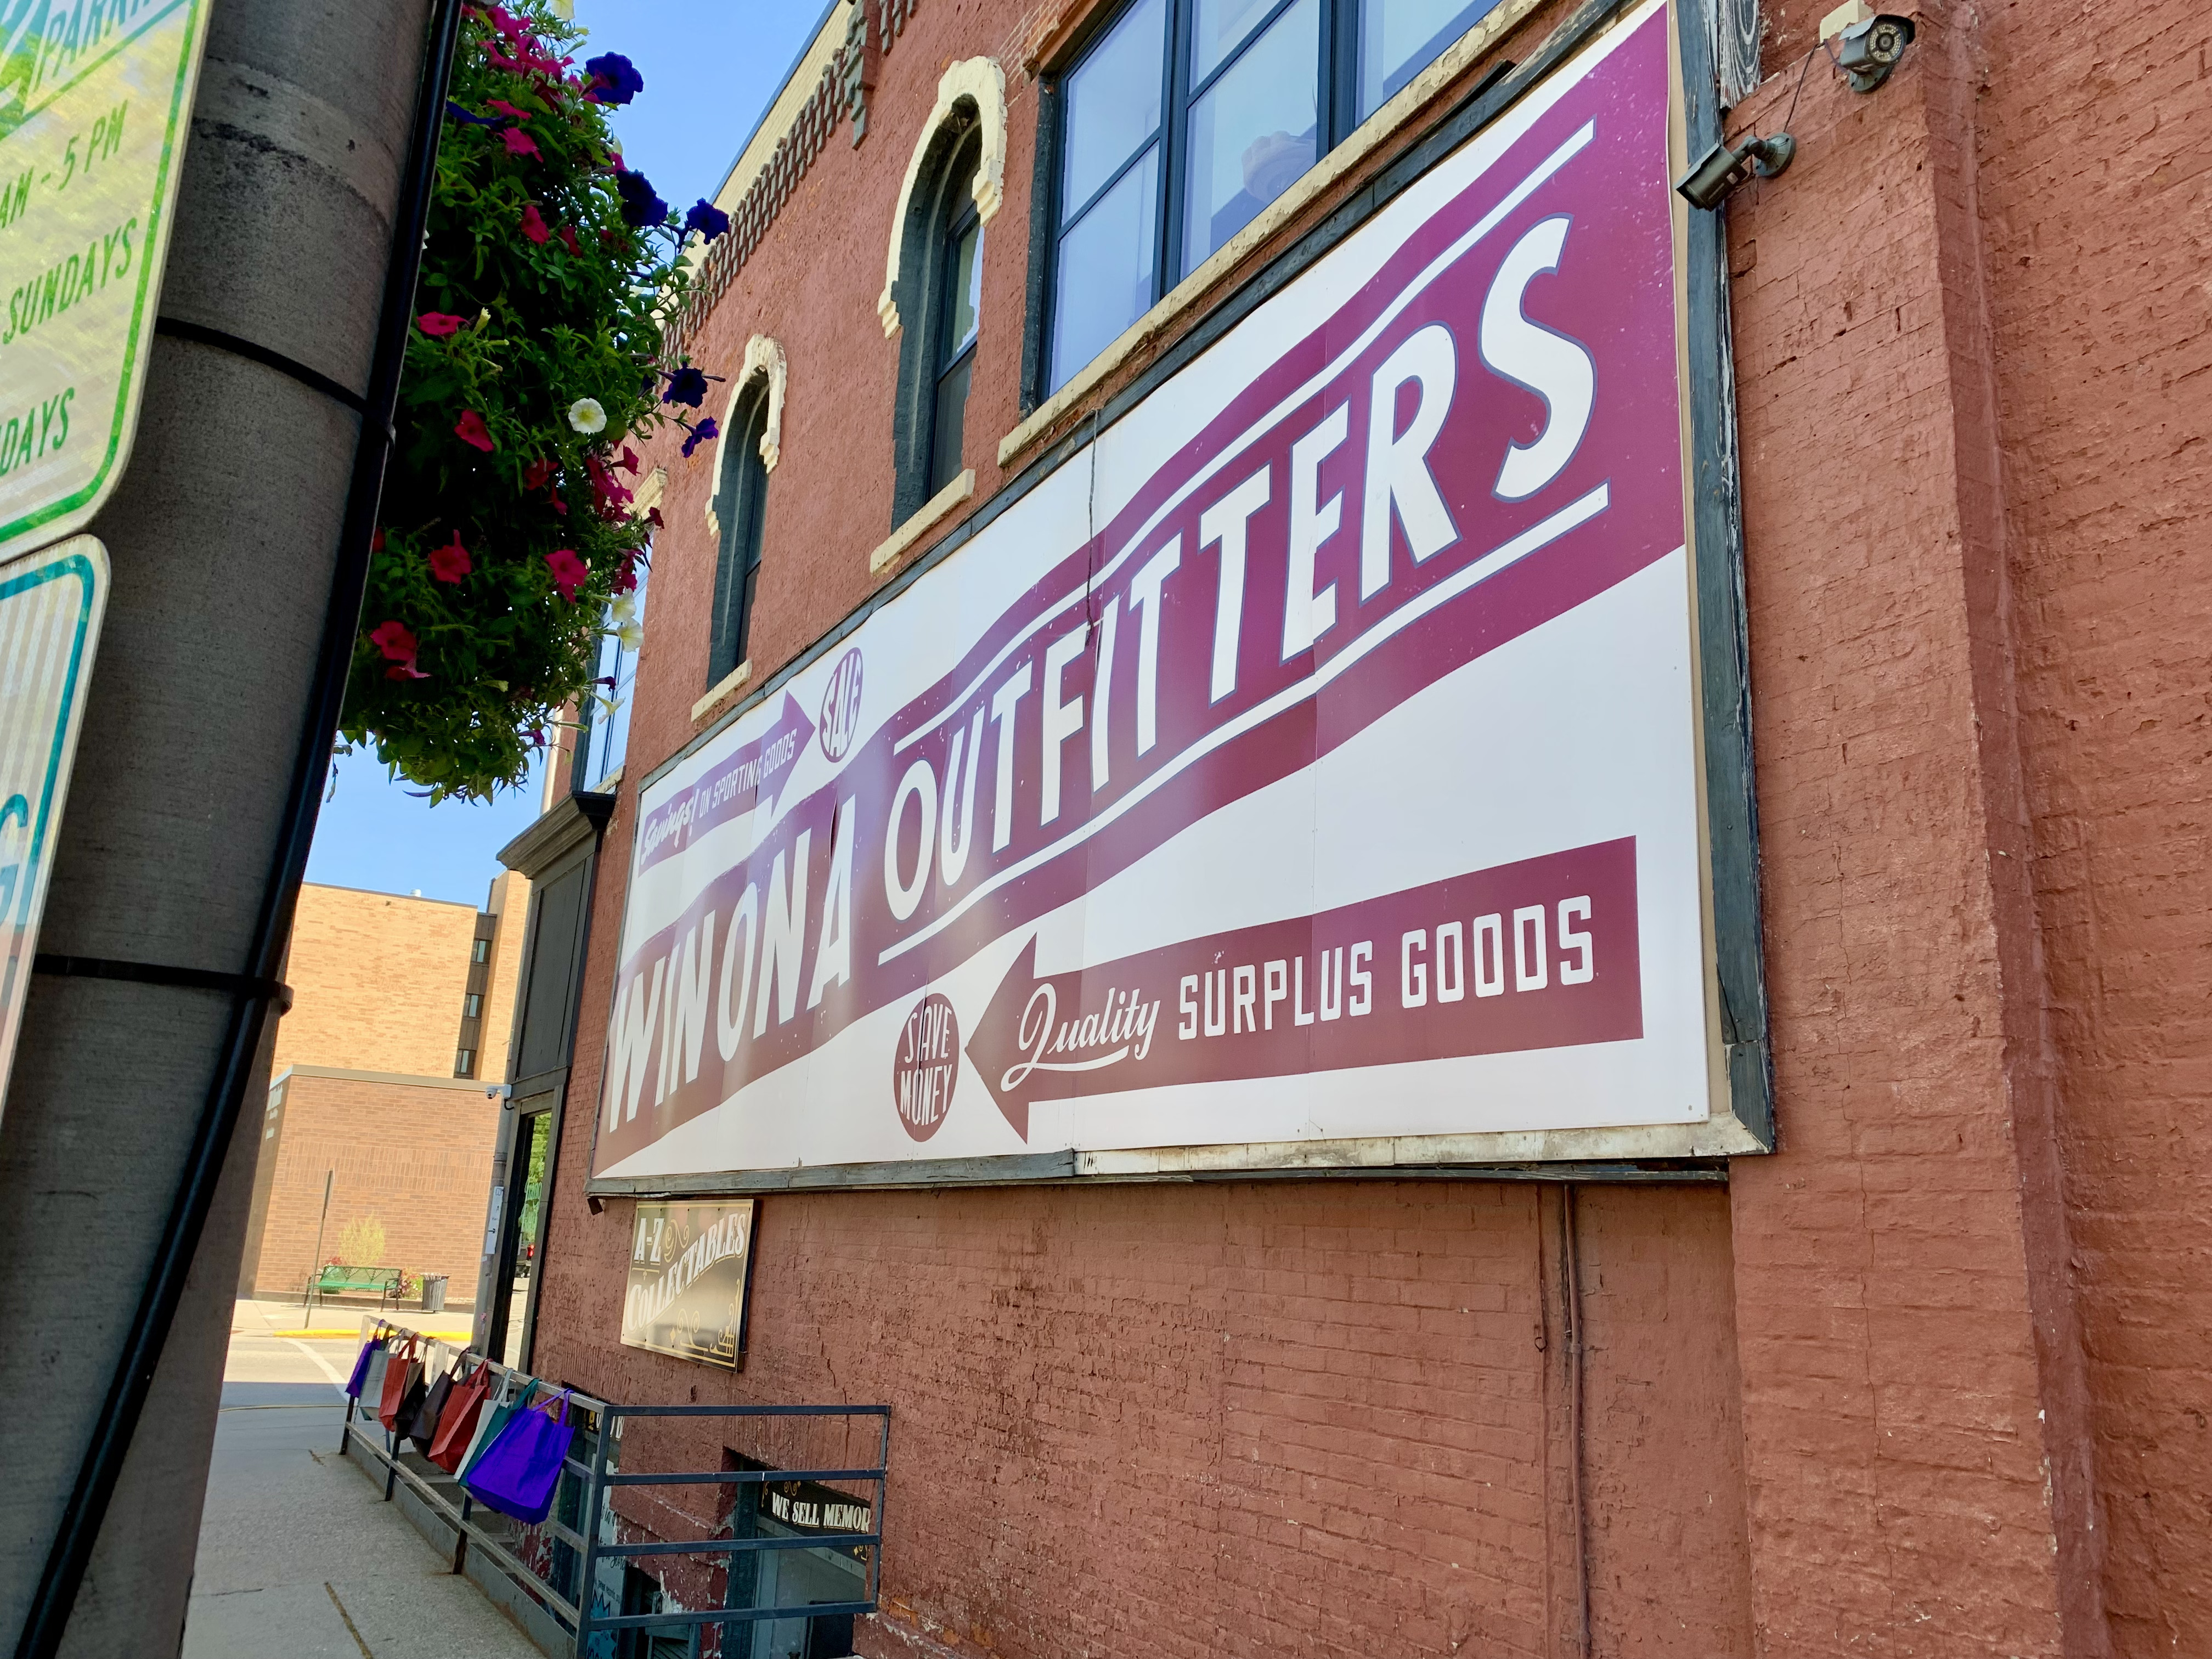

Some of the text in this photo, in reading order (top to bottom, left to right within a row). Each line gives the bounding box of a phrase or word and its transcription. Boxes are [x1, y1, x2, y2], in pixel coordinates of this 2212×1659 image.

[58, 133, 81, 191] 5
[84, 99, 128, 173] PM
[2, 217, 137, 345] SUNDAYS
[609, 212, 1598, 1133] WINONA OUTFITTERS
[822, 652, 862, 758] SALE
[640, 728, 797, 866] Savings! ON SPORTING GOODS
[904, 1003, 952, 1064] SAVE
[1001, 894, 1595, 1092] Quality SURPLUS GOODS
[900, 1063, 953, 1126] MONEY
[627, 1212, 747, 1332] COLLECTABLES
[634, 1217, 665, 1265] A-Z
[772, 1491, 871, 1534] WE SELL MEMOR
